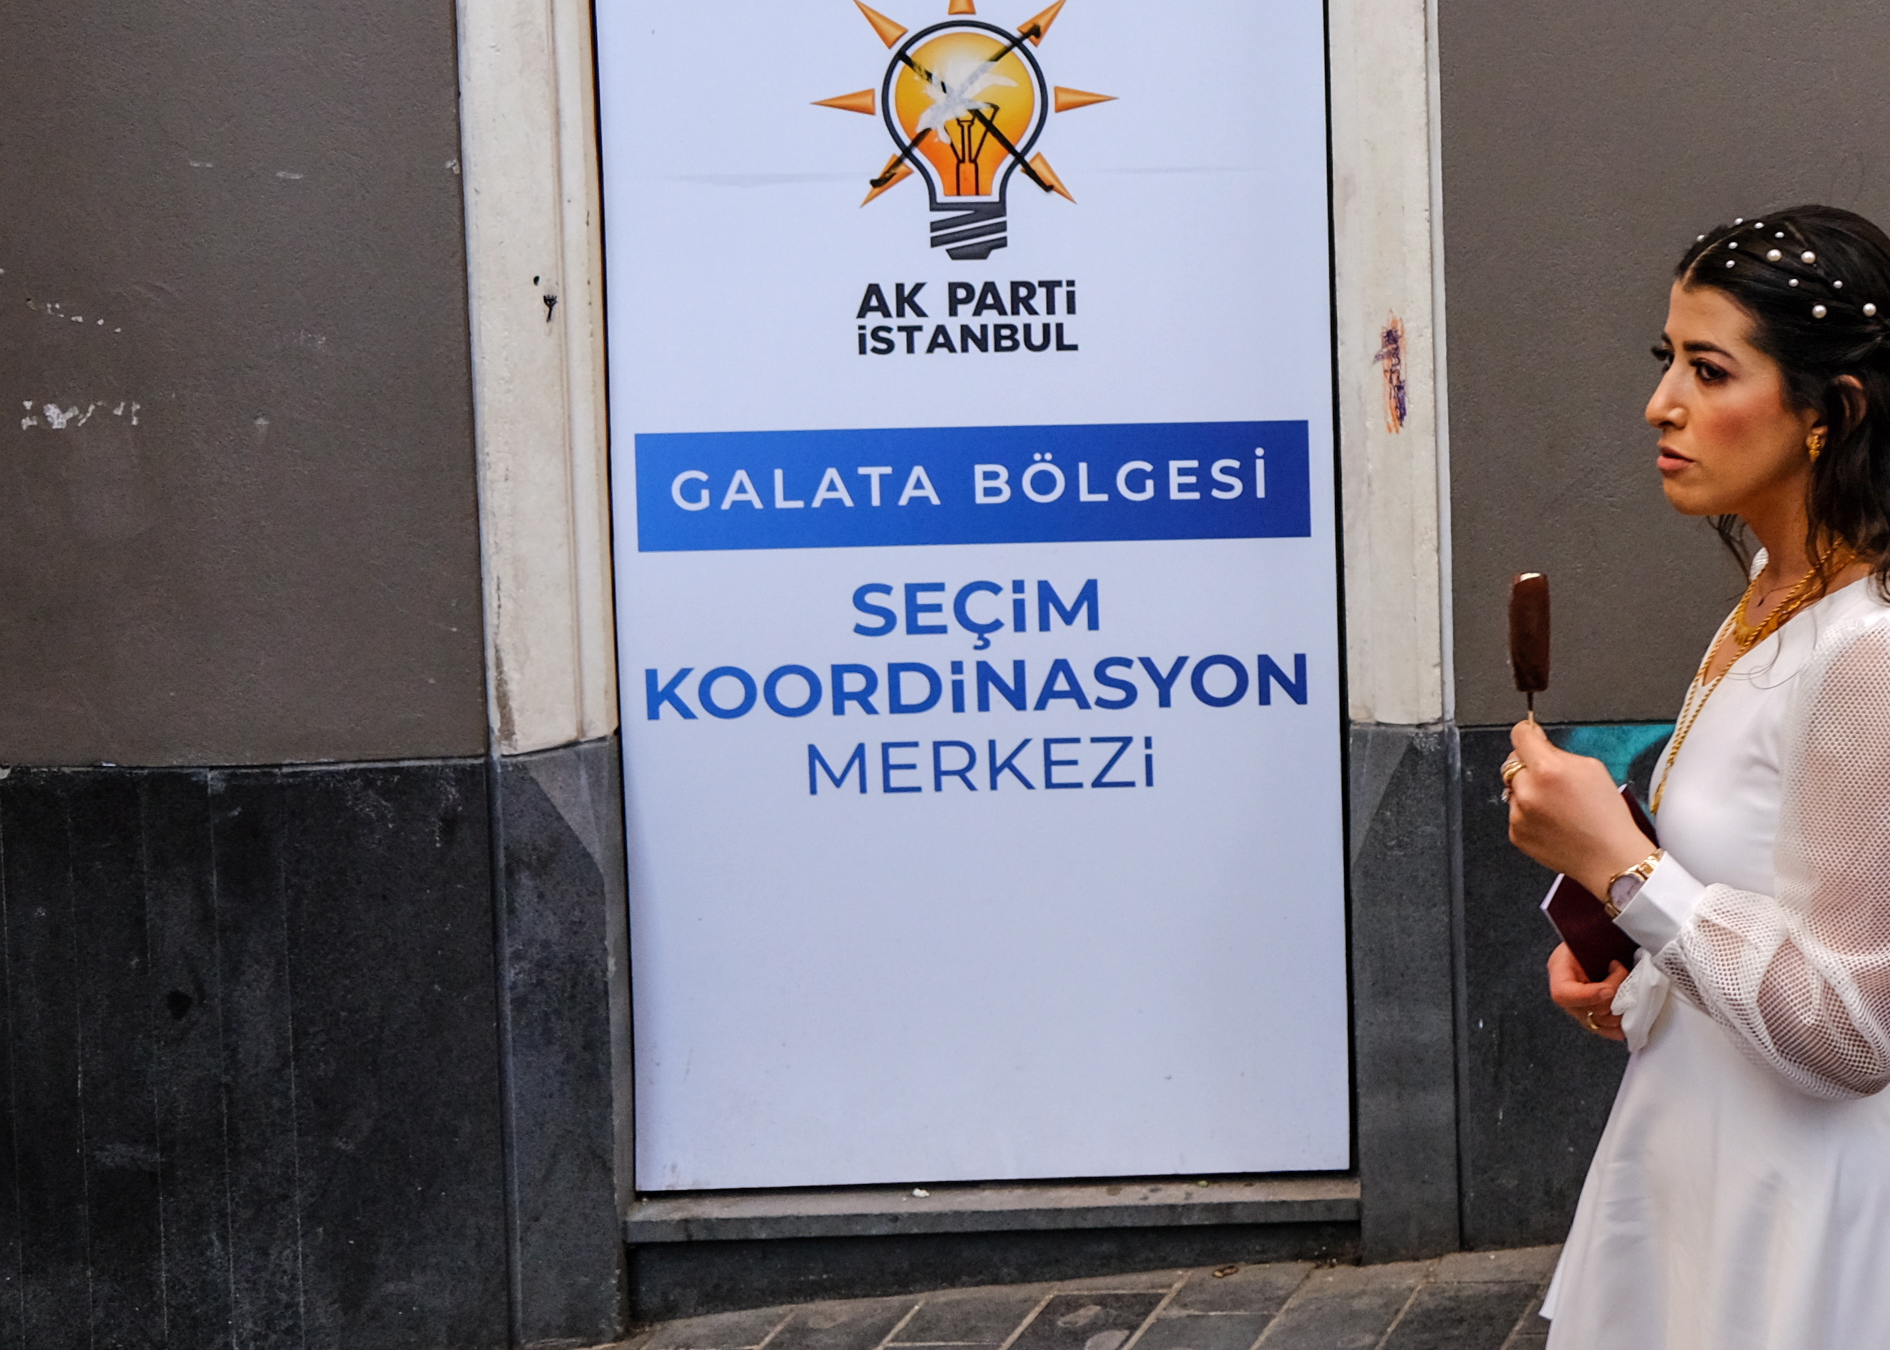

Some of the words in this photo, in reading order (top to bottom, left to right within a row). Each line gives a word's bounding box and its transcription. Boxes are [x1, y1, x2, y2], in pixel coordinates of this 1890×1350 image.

[856, 283, 929, 319] AK
[671, 465, 941, 512] GALATA
[973, 447, 1266, 505] BÖLGESİ
